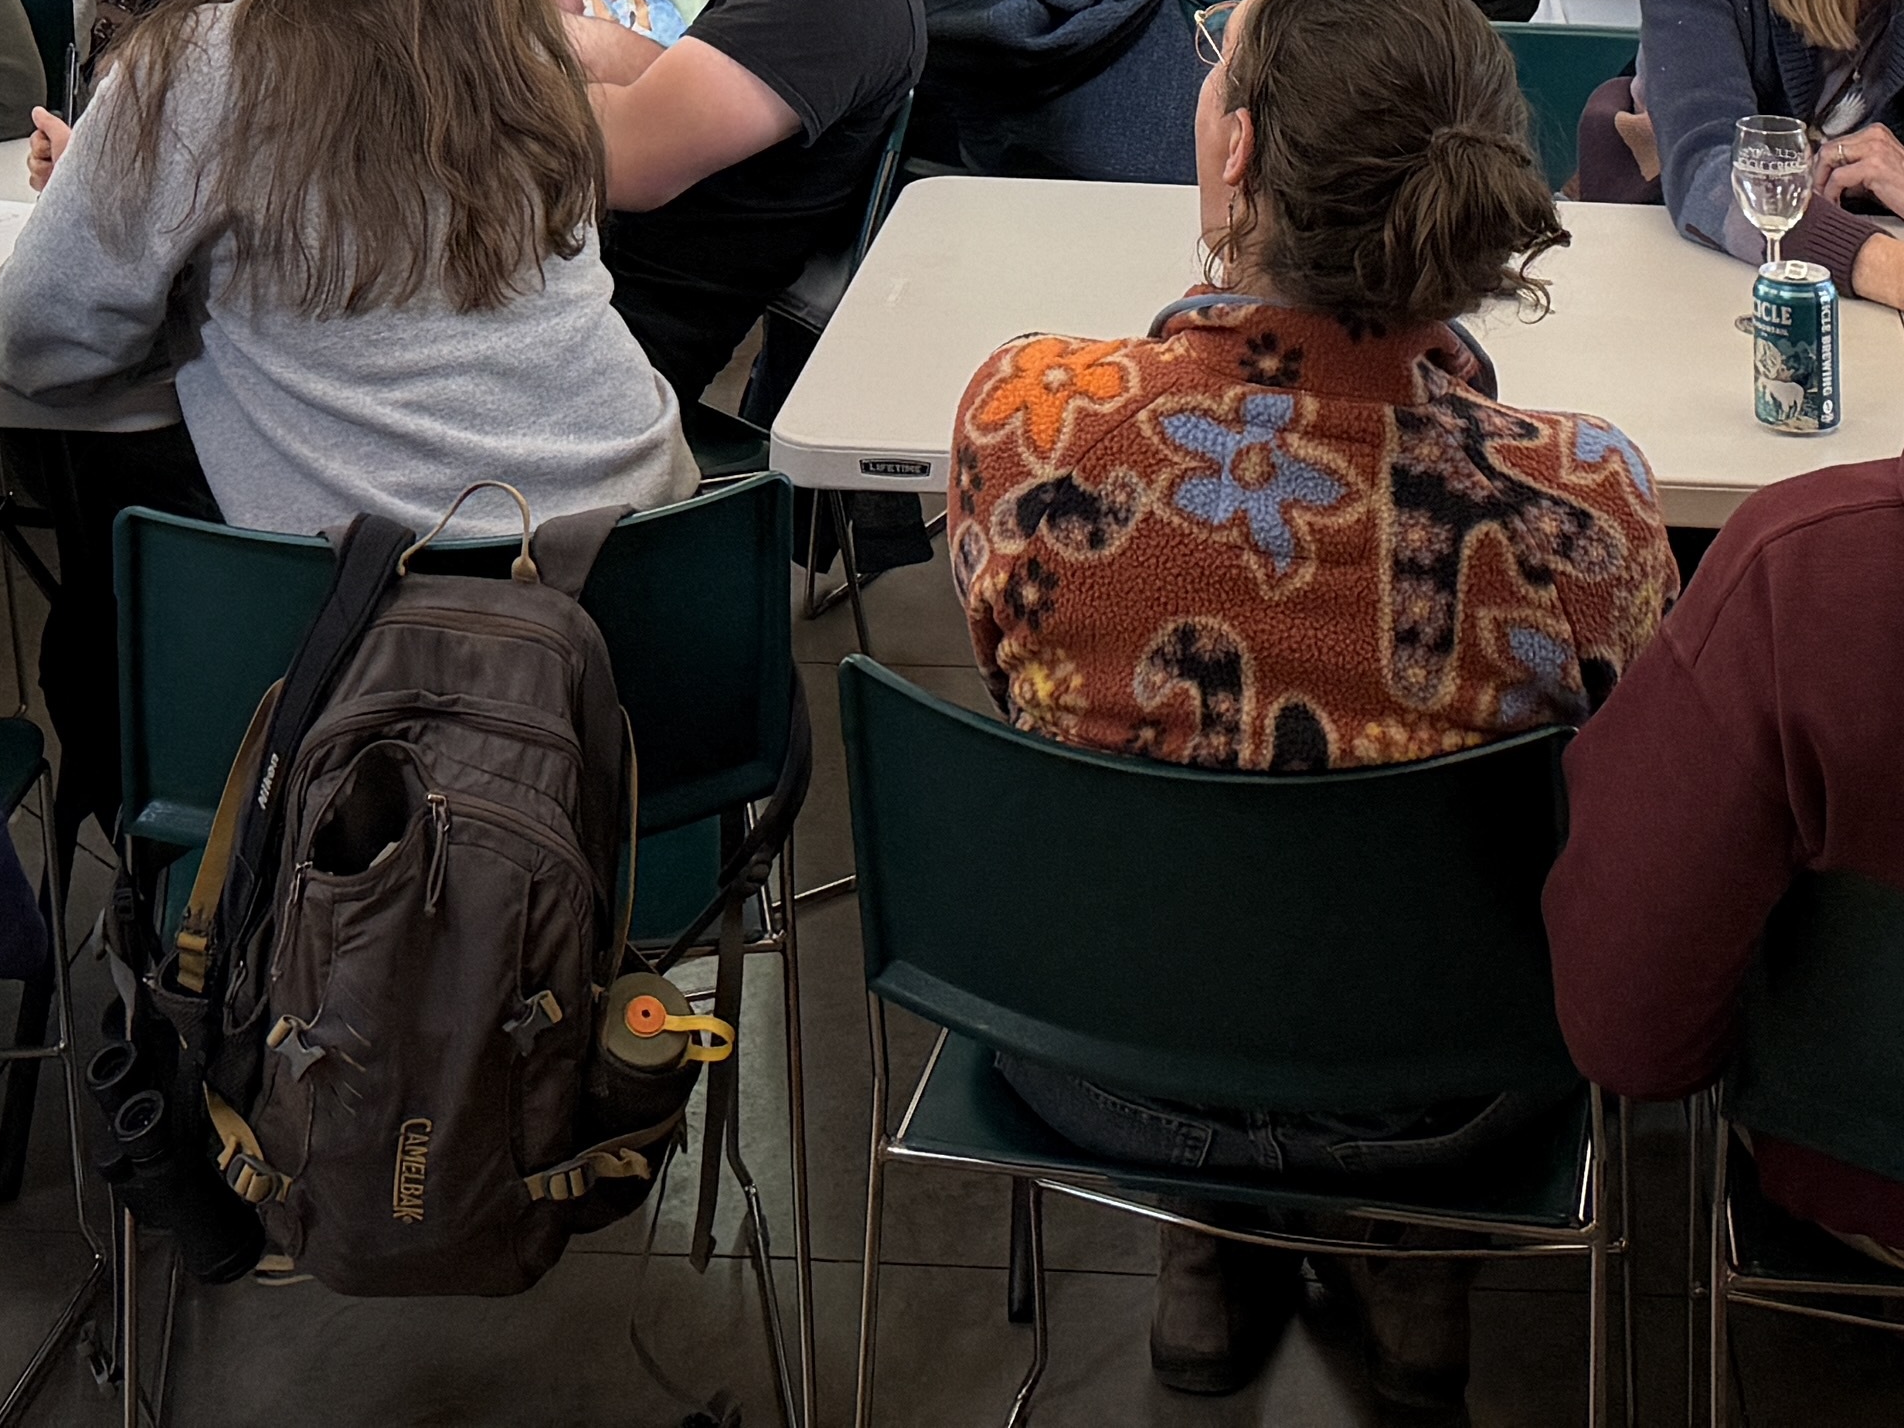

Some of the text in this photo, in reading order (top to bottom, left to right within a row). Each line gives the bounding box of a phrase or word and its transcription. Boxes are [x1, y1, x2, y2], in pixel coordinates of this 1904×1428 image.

[1817, 289, 1833, 396] ICICLE BREWING
[257, 752, 279, 810] Nikon
[392, 1117, 433, 1221] CAMELBAK
